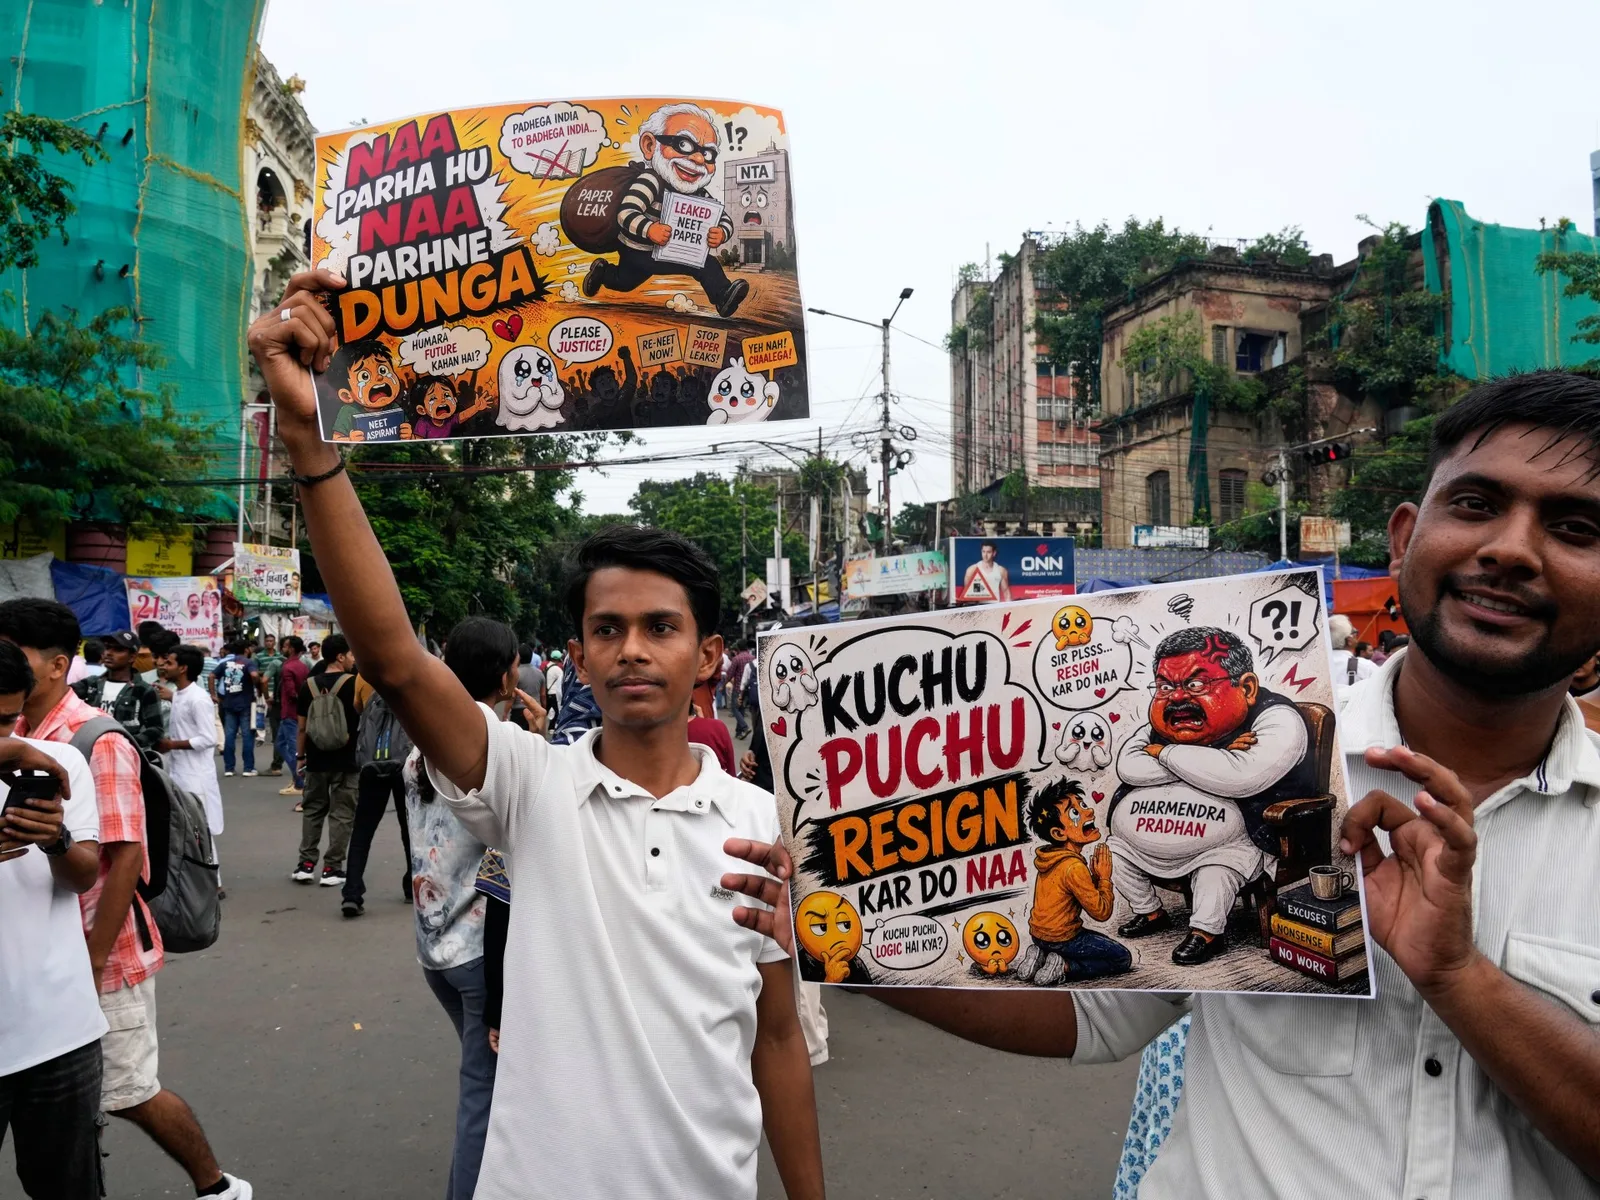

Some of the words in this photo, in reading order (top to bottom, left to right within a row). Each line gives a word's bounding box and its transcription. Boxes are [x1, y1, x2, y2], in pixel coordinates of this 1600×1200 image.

[512, 115, 552, 135] PADHEGA
[554, 111, 579, 124] INDIA
[511, 137, 524, 149] TO
[526, 126, 565, 146] BADHEGA
[567, 123, 598, 136] INDIA...
[346, 113, 457, 188] NAA
[740, 164, 769, 180] NTA
[338, 162, 436, 221] PARHA
[446, 147, 488, 187] HU
[577, 188, 613, 203] PAPER
[360, 185, 480, 253] NAA
[576, 203, 607, 217] LEAK
[674, 201, 711, 220] LEAKED
[677, 217, 703, 232] NEET
[673, 230, 703, 246] PAPER
[350, 229, 489, 289] PARHNE
[339, 249, 536, 344] DUNGA
[412, 332, 449, 351] HUMARA
[560, 326, 601, 339] PLEASE
[642, 334, 675, 350] RE-NEET
[695, 330, 720, 341] STOP
[424, 343, 458, 359] FUTURE
[556, 339, 607, 354] JUSTICE!
[649, 347, 673, 361] NOW!
[692, 340, 720, 352] PAPER
[748, 342, 763, 354] YEH
[765, 338, 787, 350] NAH!
[431, 357, 460, 372] KAHAN
[461, 350, 481, 365] HAI?
[689, 352, 720, 364] LEAKS!
[748, 348, 792, 366] CHAALEGA!
[366, 426, 398, 441] ASPIRANT
[368, 418, 388, 430] NEET
[1021, 556, 1063, 571] ONN
[137, 594, 160, 619] 21
[160, 612, 175, 622] July
[1260, 600, 1302, 641] ?!
[1051, 653, 1068, 668] SIR
[1071, 643, 1113, 663] PLSSS...
[1057, 658, 1100, 682] RESIGN
[820, 640, 987, 737] KUCHU
[1051, 682, 1075, 697] KAR
[1076, 676, 1091, 692] DO
[1095, 671, 1118, 686] NAA
[818, 696, 1026, 810] PUCHU
[1130, 800, 1226, 822] DHARMENDRA
[828, 780, 1019, 881] RESIGN
[1135, 817, 1207, 838] PRADHAN
[858, 875, 913, 916] KAR
[919, 864, 957, 904] DO
[966, 848, 1027, 894] NAA
[1288, 904, 1327, 925] EXCUSES
[882, 926, 910, 941] KUCHU
[912, 923, 938, 937] PUCHU
[1277, 923, 1323, 949] NONSENSE
[876, 942, 903, 958] LOGIC
[905, 940, 919, 954] HAI
[922, 936, 943, 952] KYA?
[1278, 946, 1293, 962] NO
[1296, 956, 1327, 976] WORK
